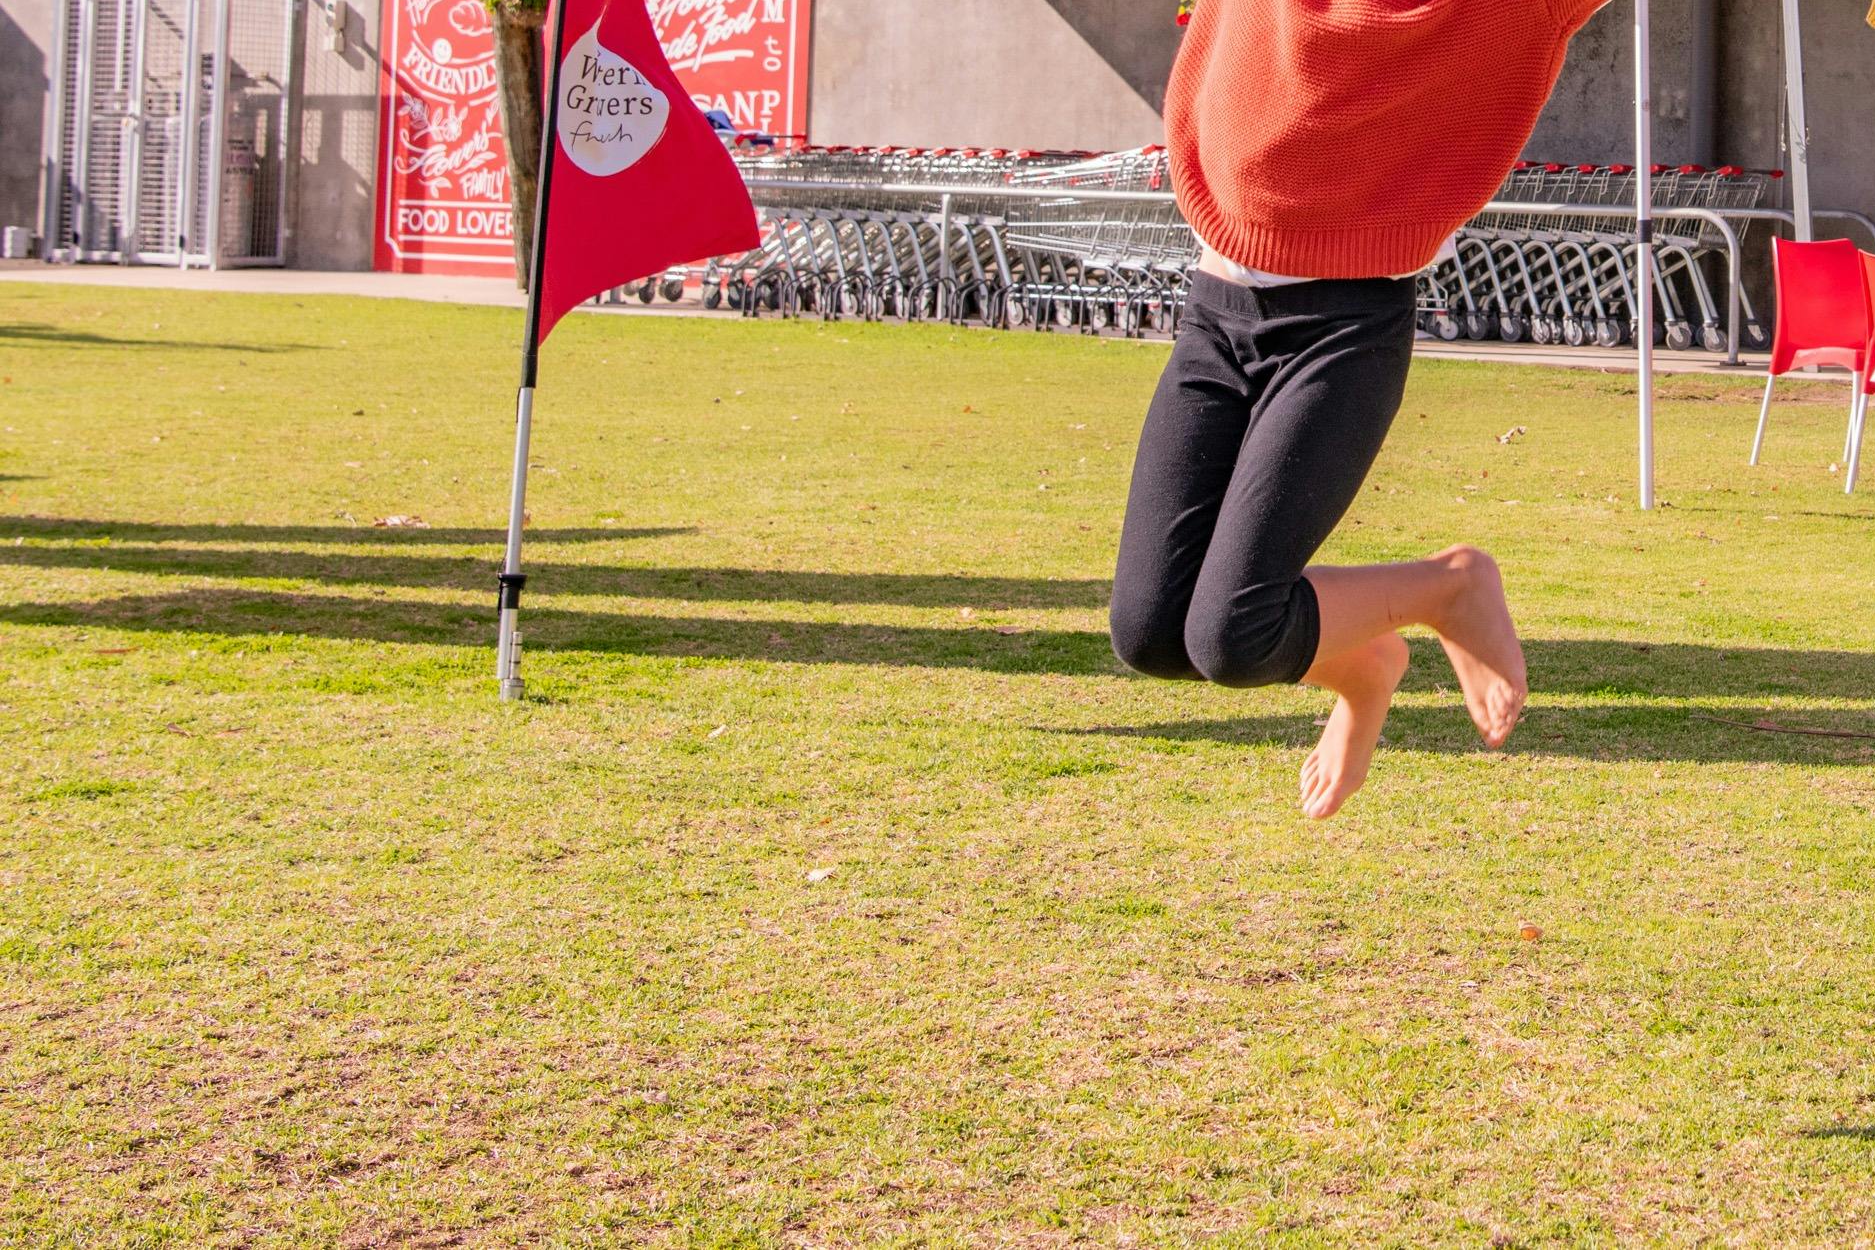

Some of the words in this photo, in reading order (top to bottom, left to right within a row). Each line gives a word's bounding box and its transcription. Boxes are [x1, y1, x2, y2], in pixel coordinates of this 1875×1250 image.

[459, 169, 505, 201] FAMILY
[398, 208, 450, 233] FOOD
[456, 210, 513, 236] LOVER
